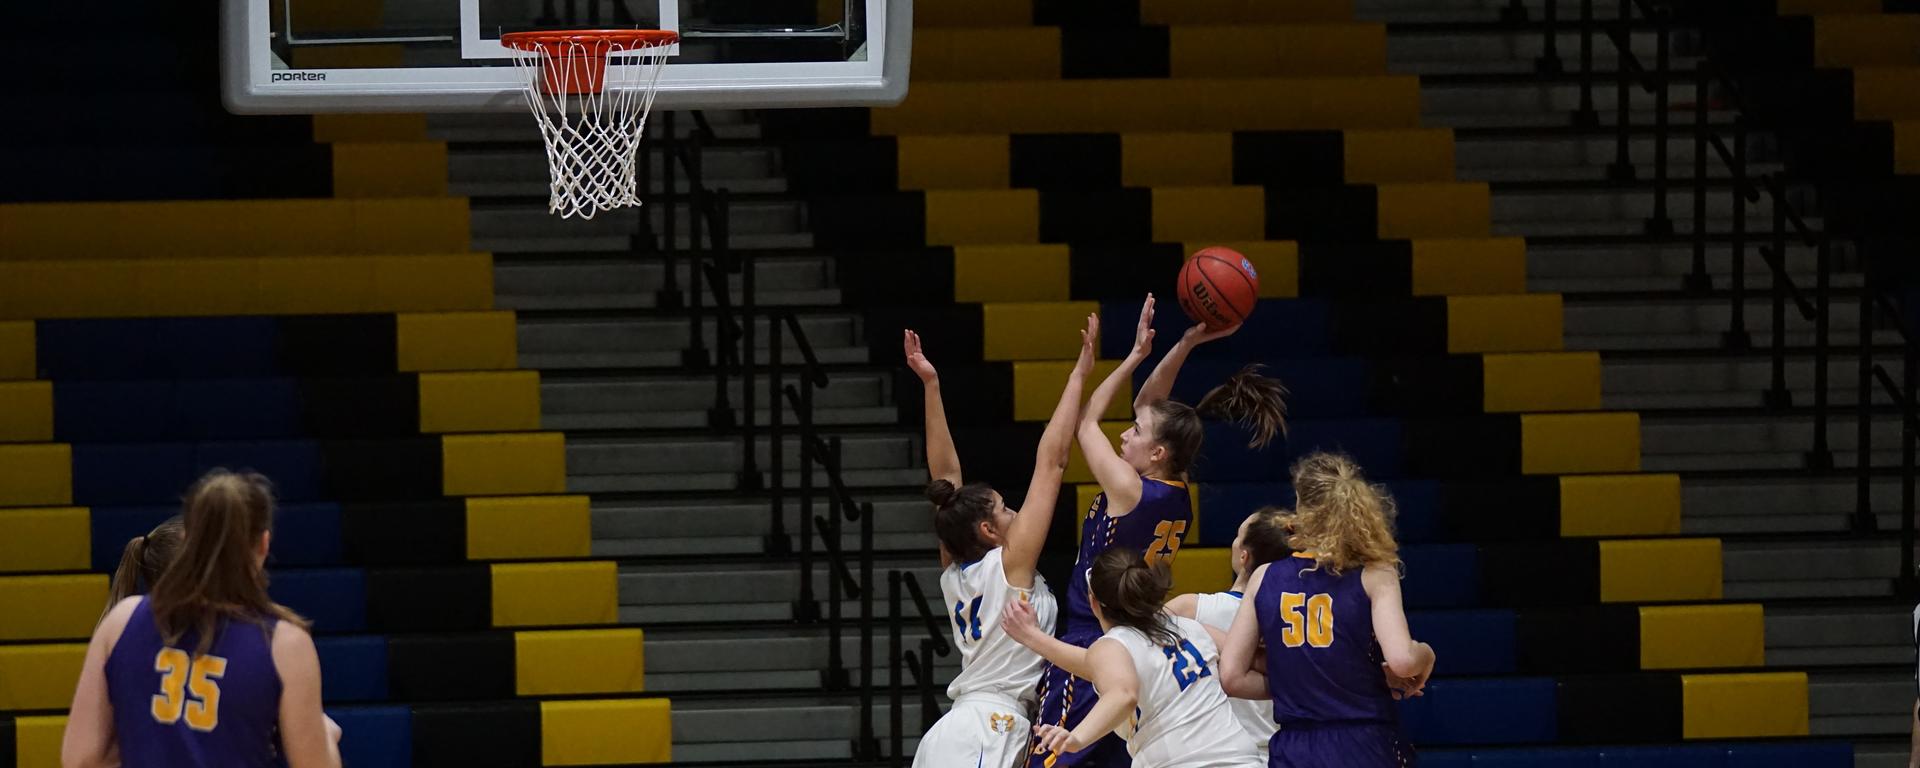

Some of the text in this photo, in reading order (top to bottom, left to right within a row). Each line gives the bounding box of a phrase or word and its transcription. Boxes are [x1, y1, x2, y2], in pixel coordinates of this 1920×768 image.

[1144, 519, 1187, 569] 25
[1280, 591, 1335, 649] 50
[151, 646, 228, 733] 35
[1163, 639, 1212, 692] 21
